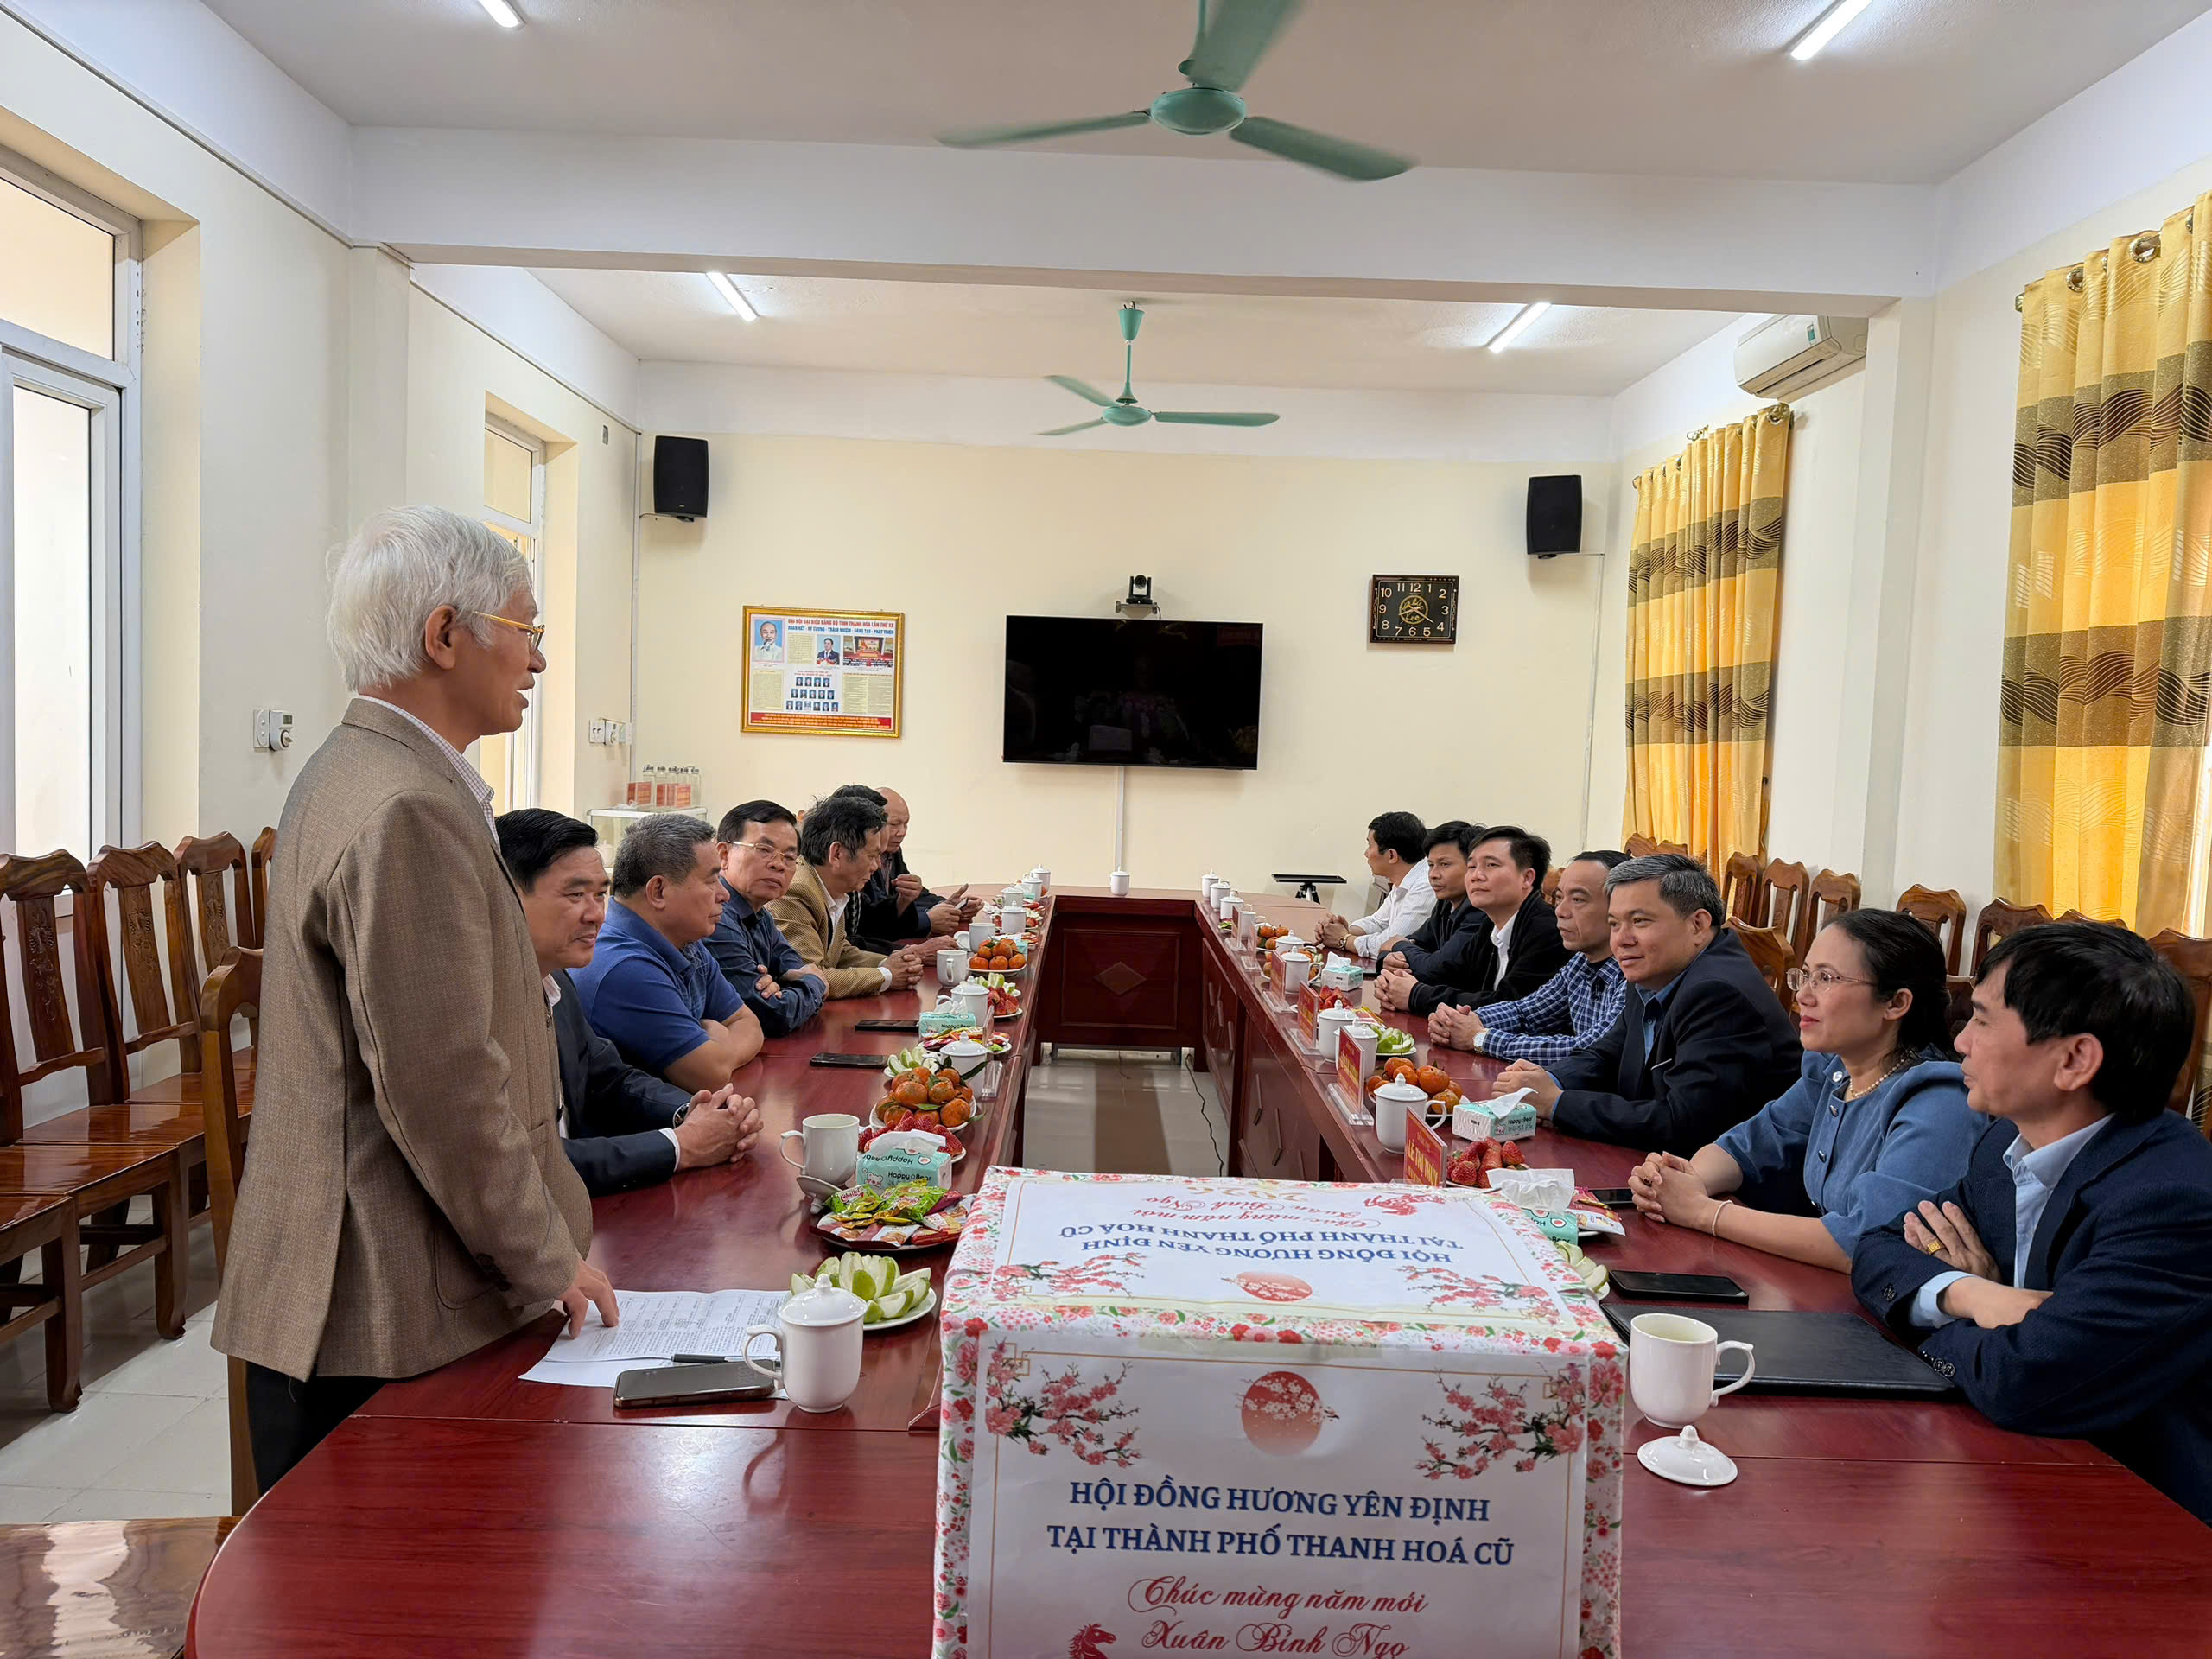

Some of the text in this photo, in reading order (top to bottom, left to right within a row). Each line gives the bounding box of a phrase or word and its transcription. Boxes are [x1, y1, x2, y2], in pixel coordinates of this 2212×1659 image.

[1397, 583, 1405, 592] 11
[1410, 582, 1421, 592] 12
[1427, 584, 1432, 593] 1
[1381, 588, 1392, 598] 10
[1439, 588, 1446, 599] 2
[1379, 604, 1387, 613] 9
[1441, 606, 1449, 615] 3
[1382, 620, 1389, 630] 8
[1436, 622, 1445, 632] 4
[1395, 626, 1402, 636] 7
[1408, 626, 1417, 636] 6
[1423, 627, 1431, 637] 5
[1059, 1223, 1464, 1249] TẠI THÀNH PHỐ THANH HOÁ CŨ
[1081, 1236, 1454, 1263] HỘI ĐỒNG HƯƠNG YÊN ĐỊNH
[1069, 1475, 1491, 1526] HỘI ĐỒNG HƯƠNG YÊN ĐỊNH
[1046, 1523, 1515, 1566] TẠI THÀNH PHỐ THANH HOÁ CŨ
[1128, 1575, 1429, 1620] Chúc mừng năm mới
[1141, 1619, 1230, 1651] Xuân
[1236, 1621, 1329, 1654] Bính
